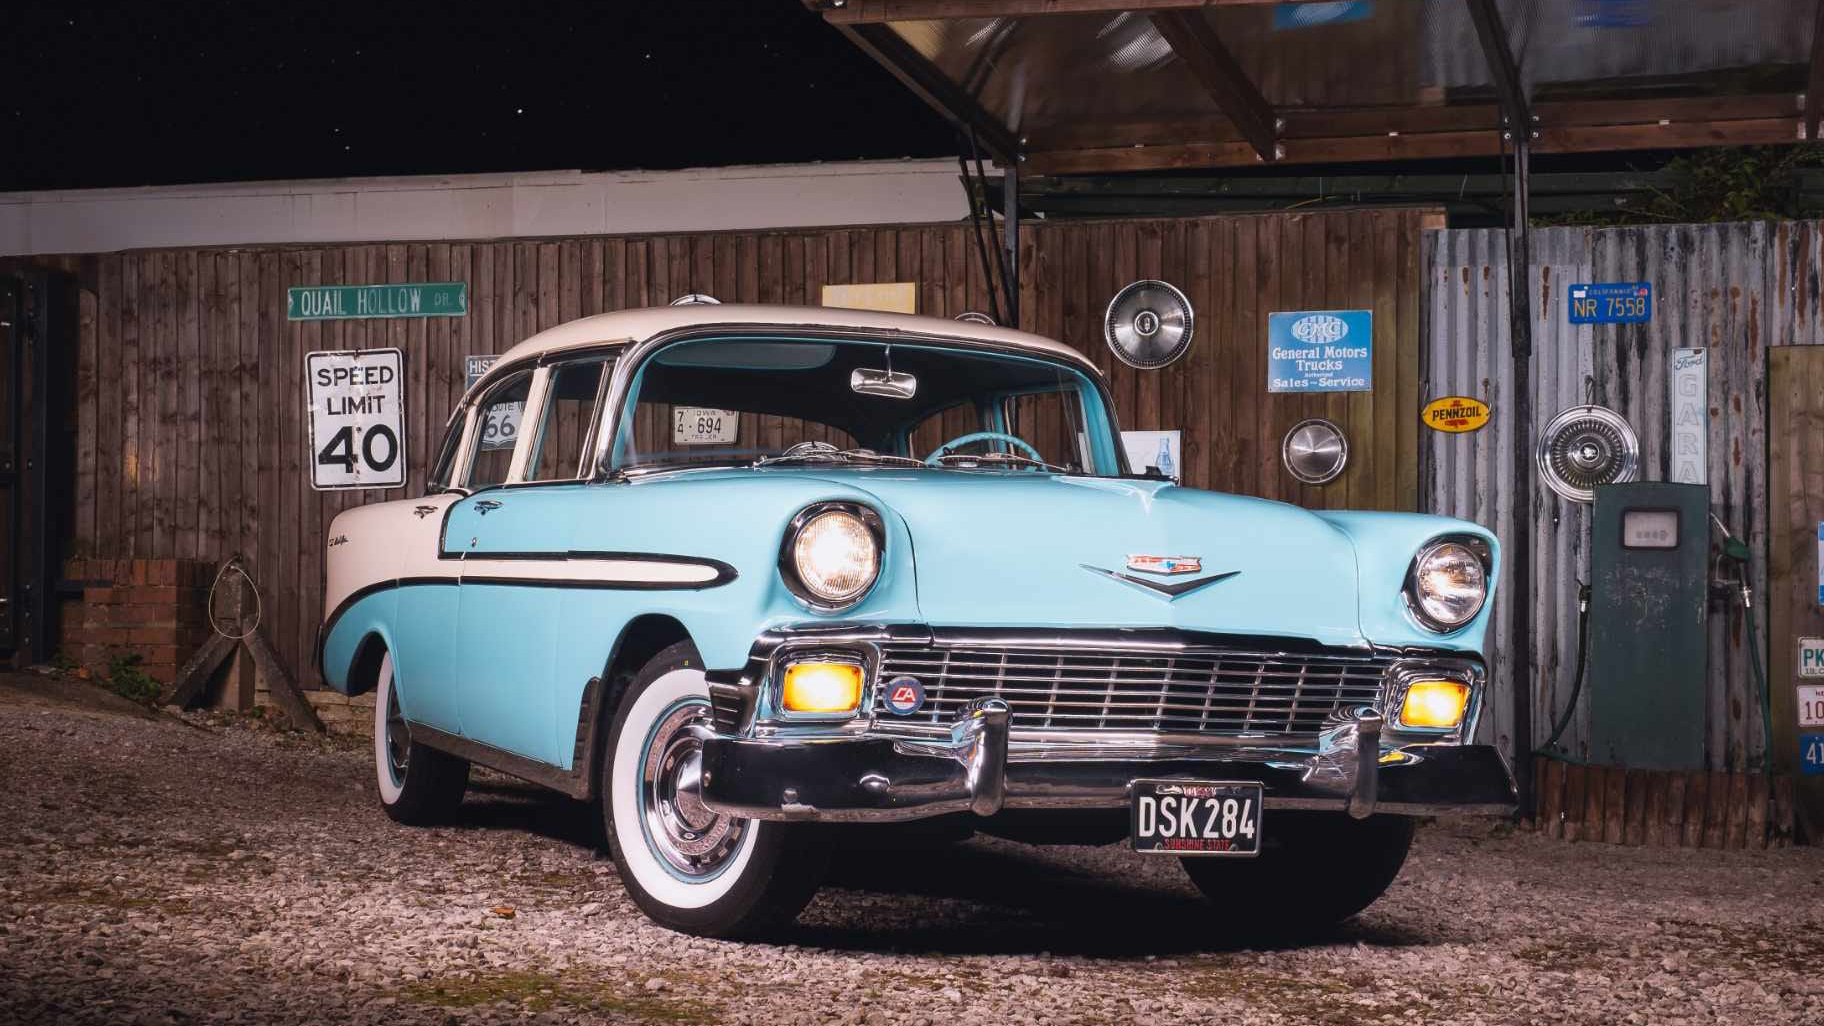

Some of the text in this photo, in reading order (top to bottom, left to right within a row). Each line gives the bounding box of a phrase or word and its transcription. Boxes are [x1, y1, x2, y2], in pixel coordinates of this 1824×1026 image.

[301, 290, 347, 316] QUAIL
[357, 287, 421, 314] HOLLOW
[1574, 297, 1645, 317] NR 7558
[1298, 321, 1342, 338] GMC
[1272, 345, 1368, 360] General Motors
[1296, 360, 1343, 371] Trucks
[1674, 355, 1704, 370] Ford
[317, 366, 394, 387] SPEED
[327, 395, 386, 415] LIMIT
[1432, 406, 1479, 421] PENNZOIL
[485, 414, 515, 438] 66
[697, 417, 721, 434] 694
[318, 424, 398, 474] 40
[1163, 838, 1203, 850] SUNSHINE
